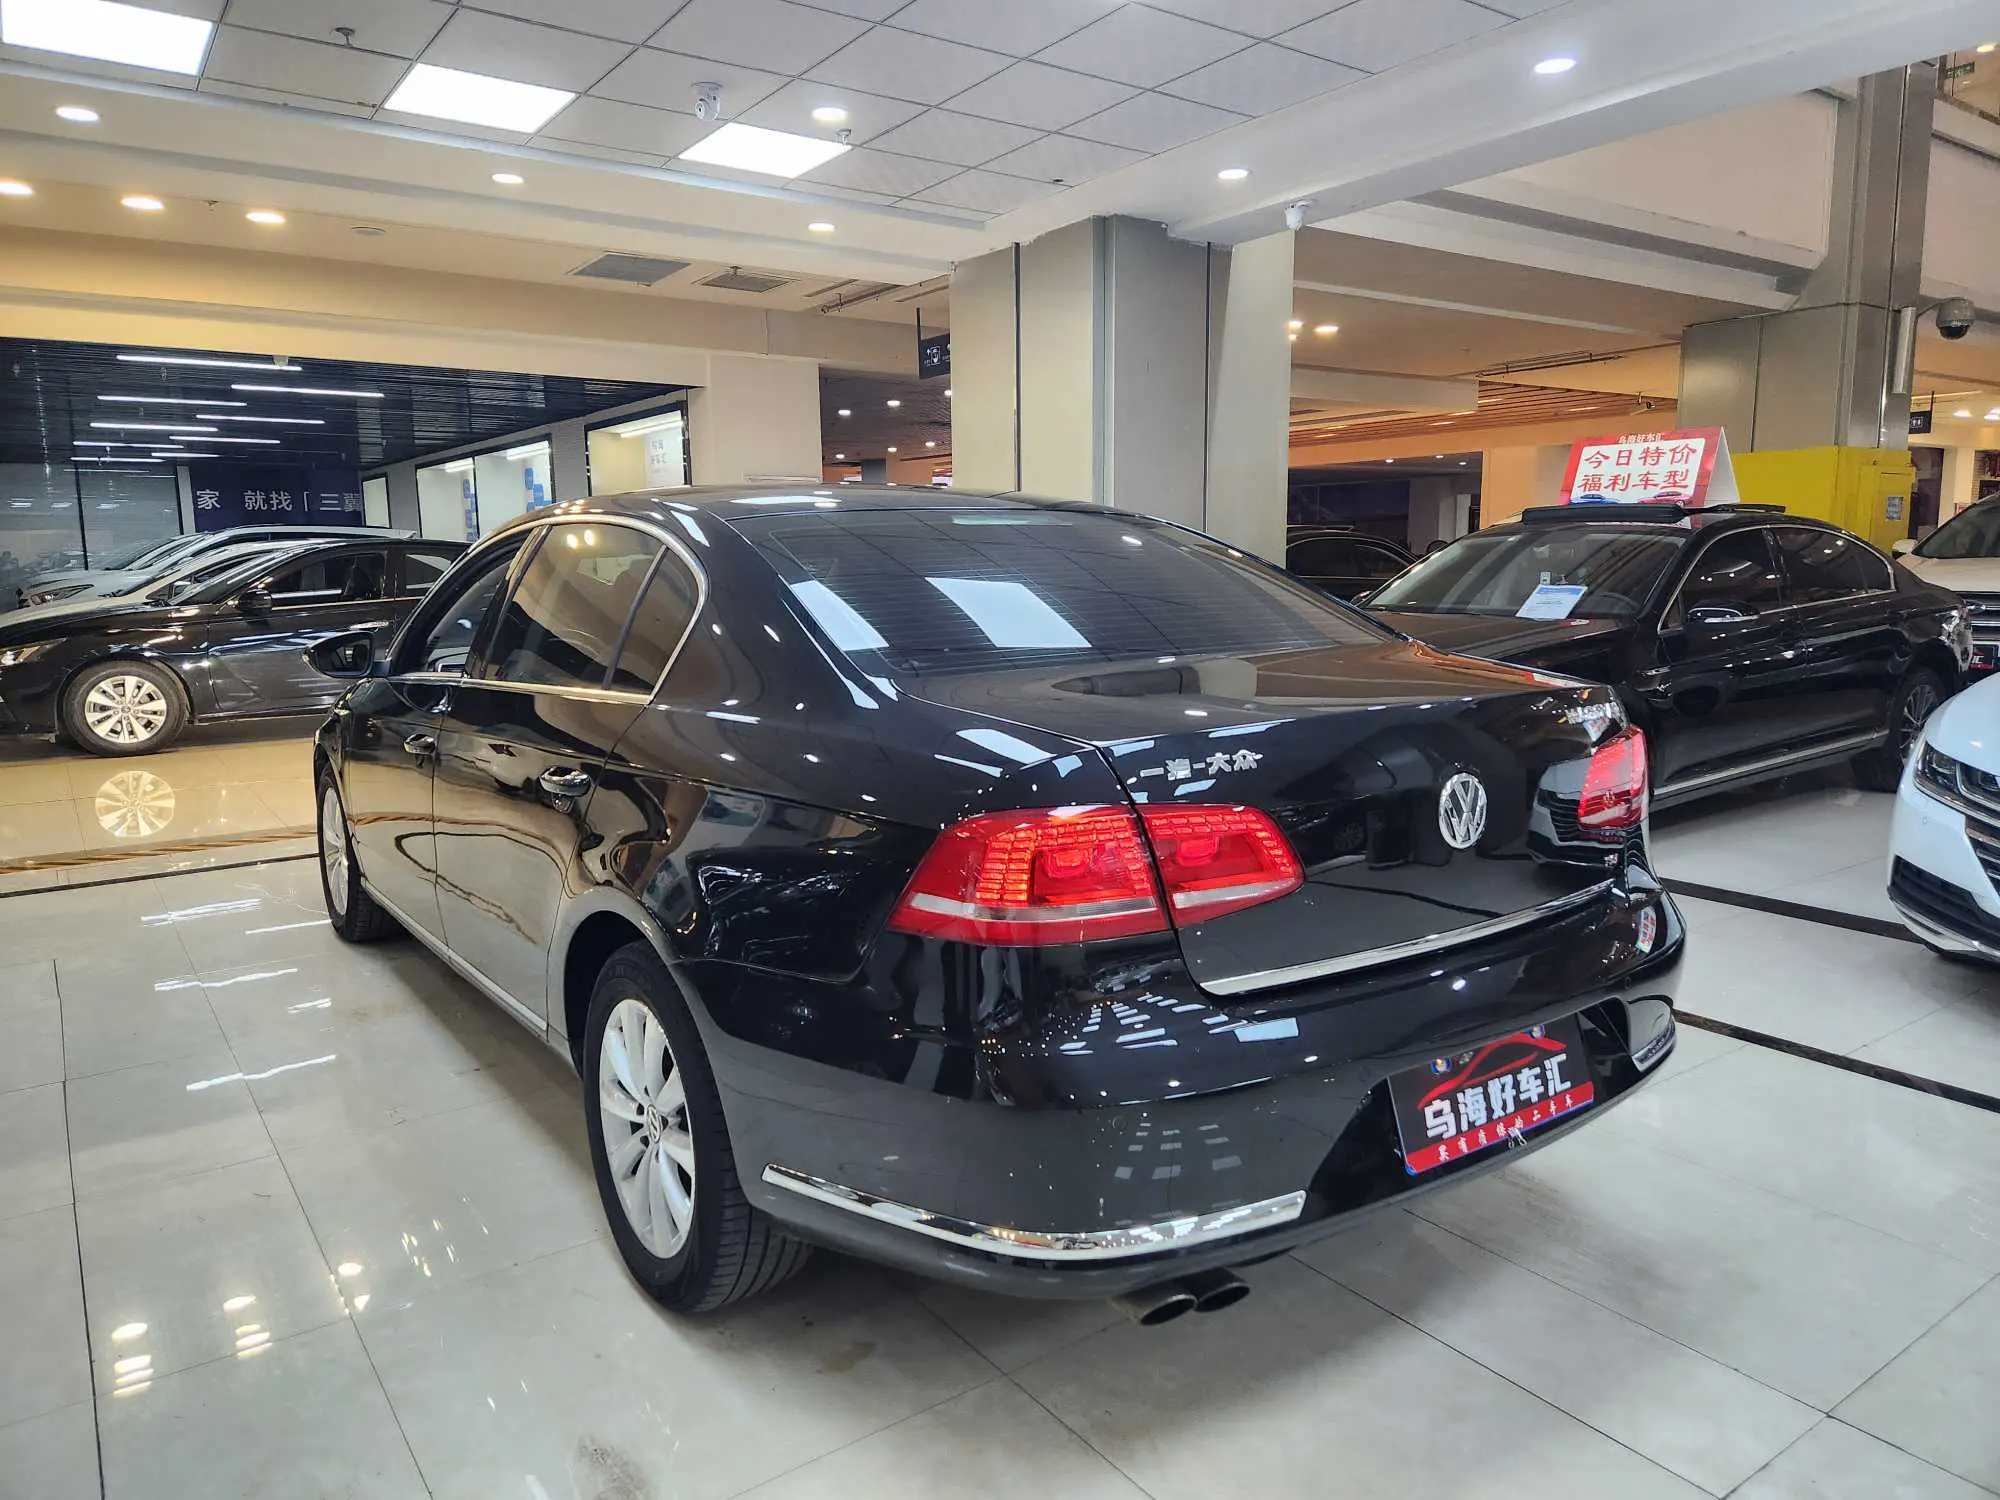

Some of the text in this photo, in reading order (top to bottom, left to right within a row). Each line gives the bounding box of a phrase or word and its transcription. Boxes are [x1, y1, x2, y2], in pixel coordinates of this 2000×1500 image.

[1584, 443, 1697, 470] 今日特价
[1577, 468, 1690, 493] 福利车型
[196, 488, 221, 510] 家
[1424, 1053, 1572, 1141] 乌海好车汇
